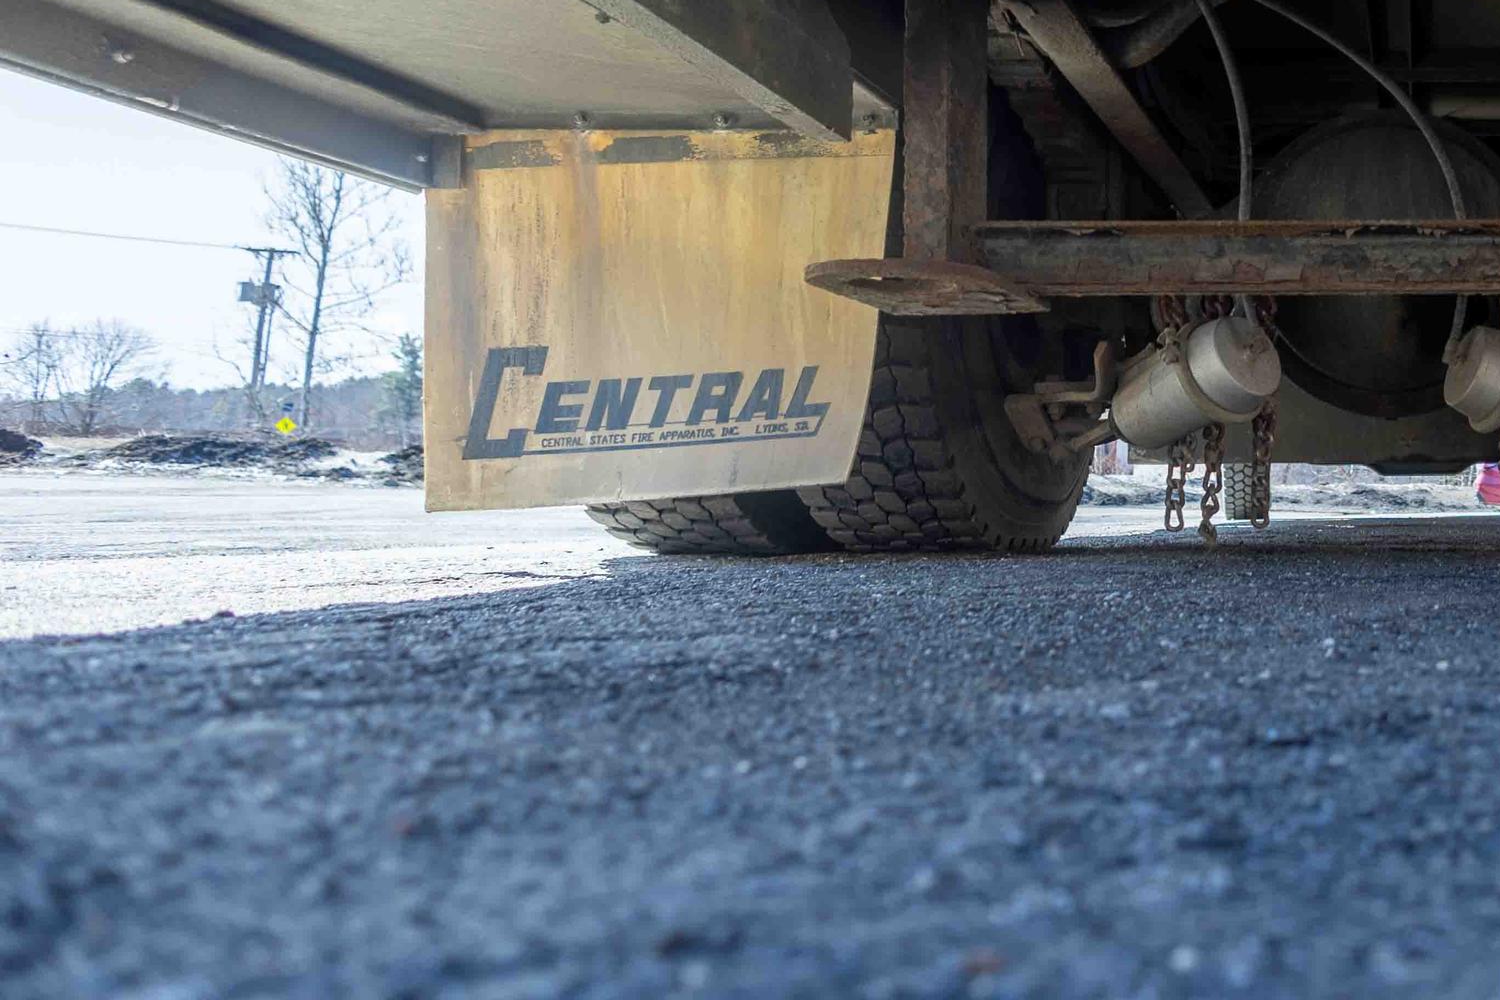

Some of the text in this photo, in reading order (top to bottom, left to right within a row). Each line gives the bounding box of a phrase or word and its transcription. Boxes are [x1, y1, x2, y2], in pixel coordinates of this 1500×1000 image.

[462, 346, 832, 460] CENTRAL
[541, 436, 584, 448] CENTRAL
[589, 433, 626, 446] STATES
[631, 431, 655, 443] FIRE
